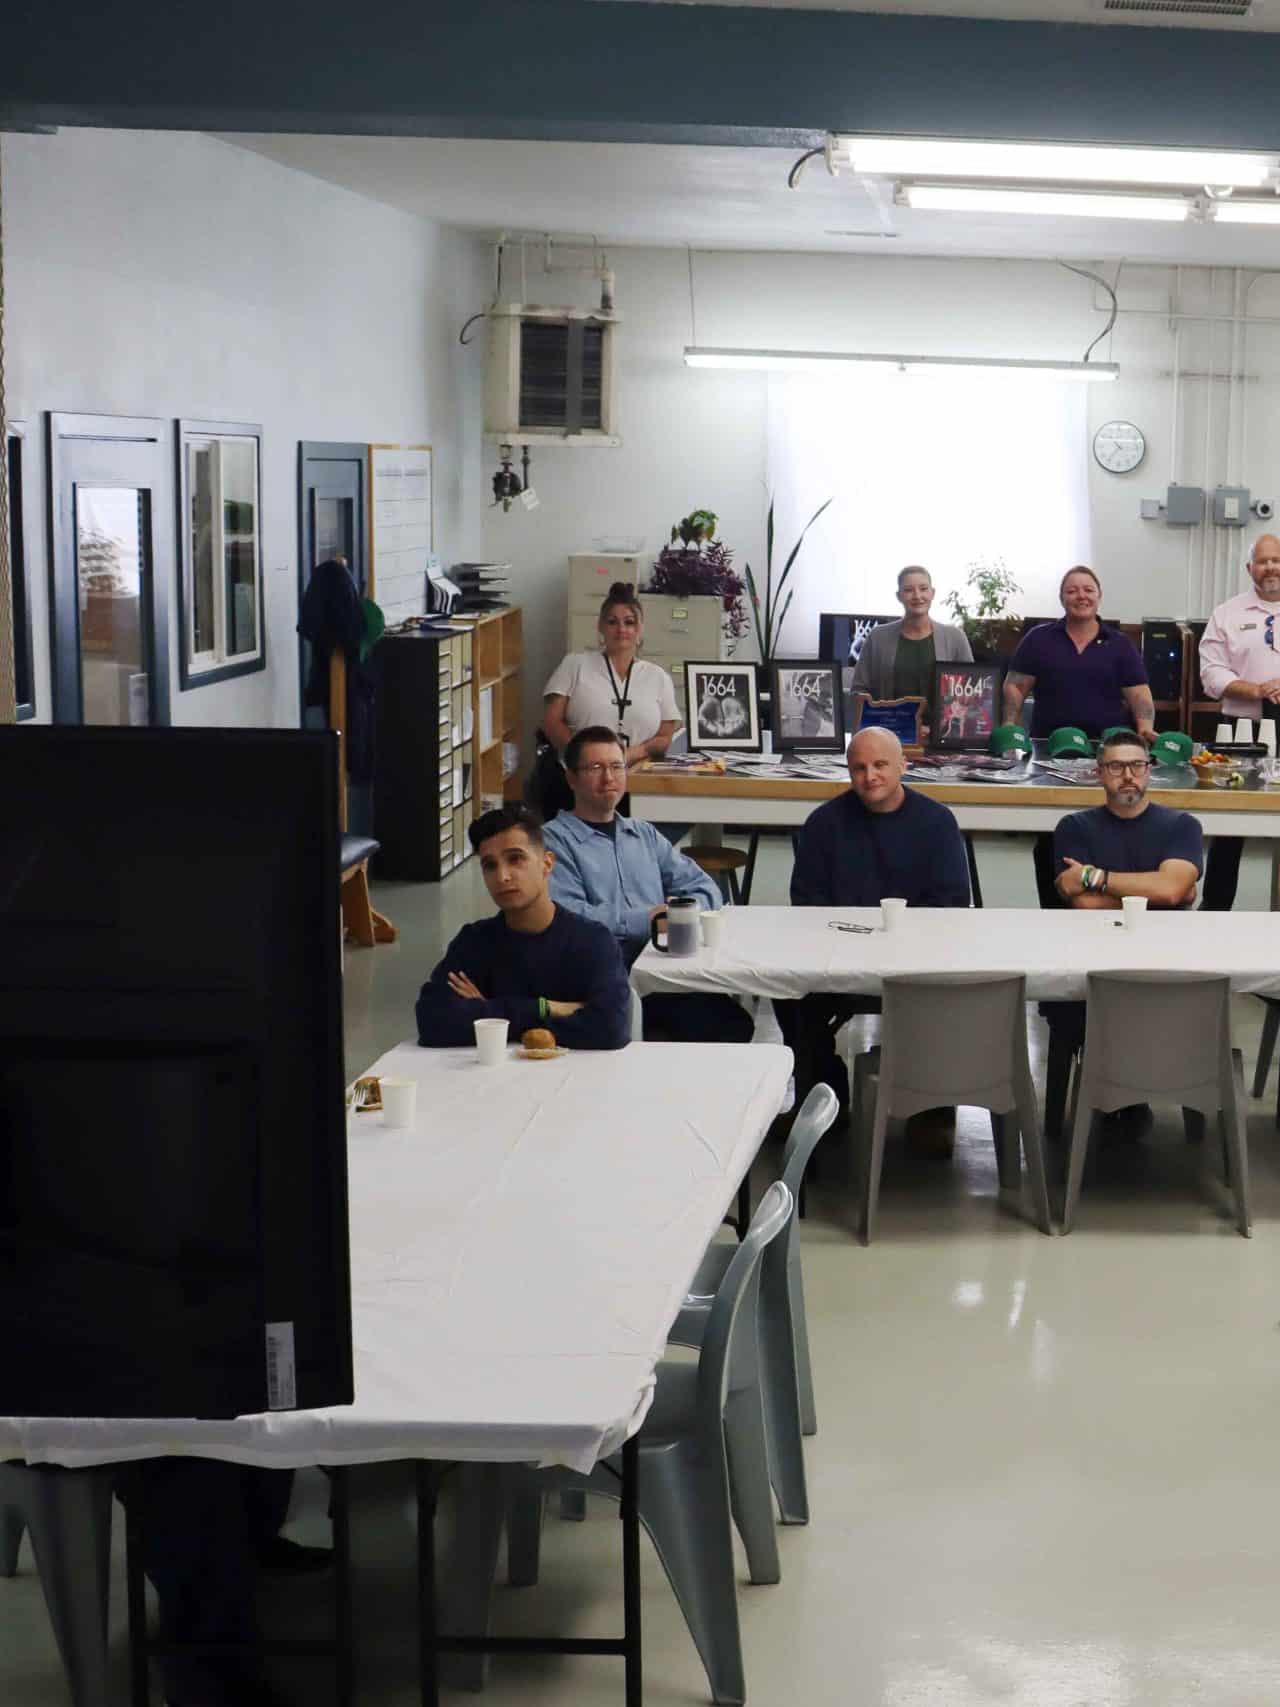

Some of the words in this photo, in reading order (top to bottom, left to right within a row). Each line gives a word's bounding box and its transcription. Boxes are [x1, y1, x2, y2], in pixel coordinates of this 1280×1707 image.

[700, 675, 737, 697] 1664
[789, 675, 821, 697] 1664
[949, 675, 984, 697] 1664
